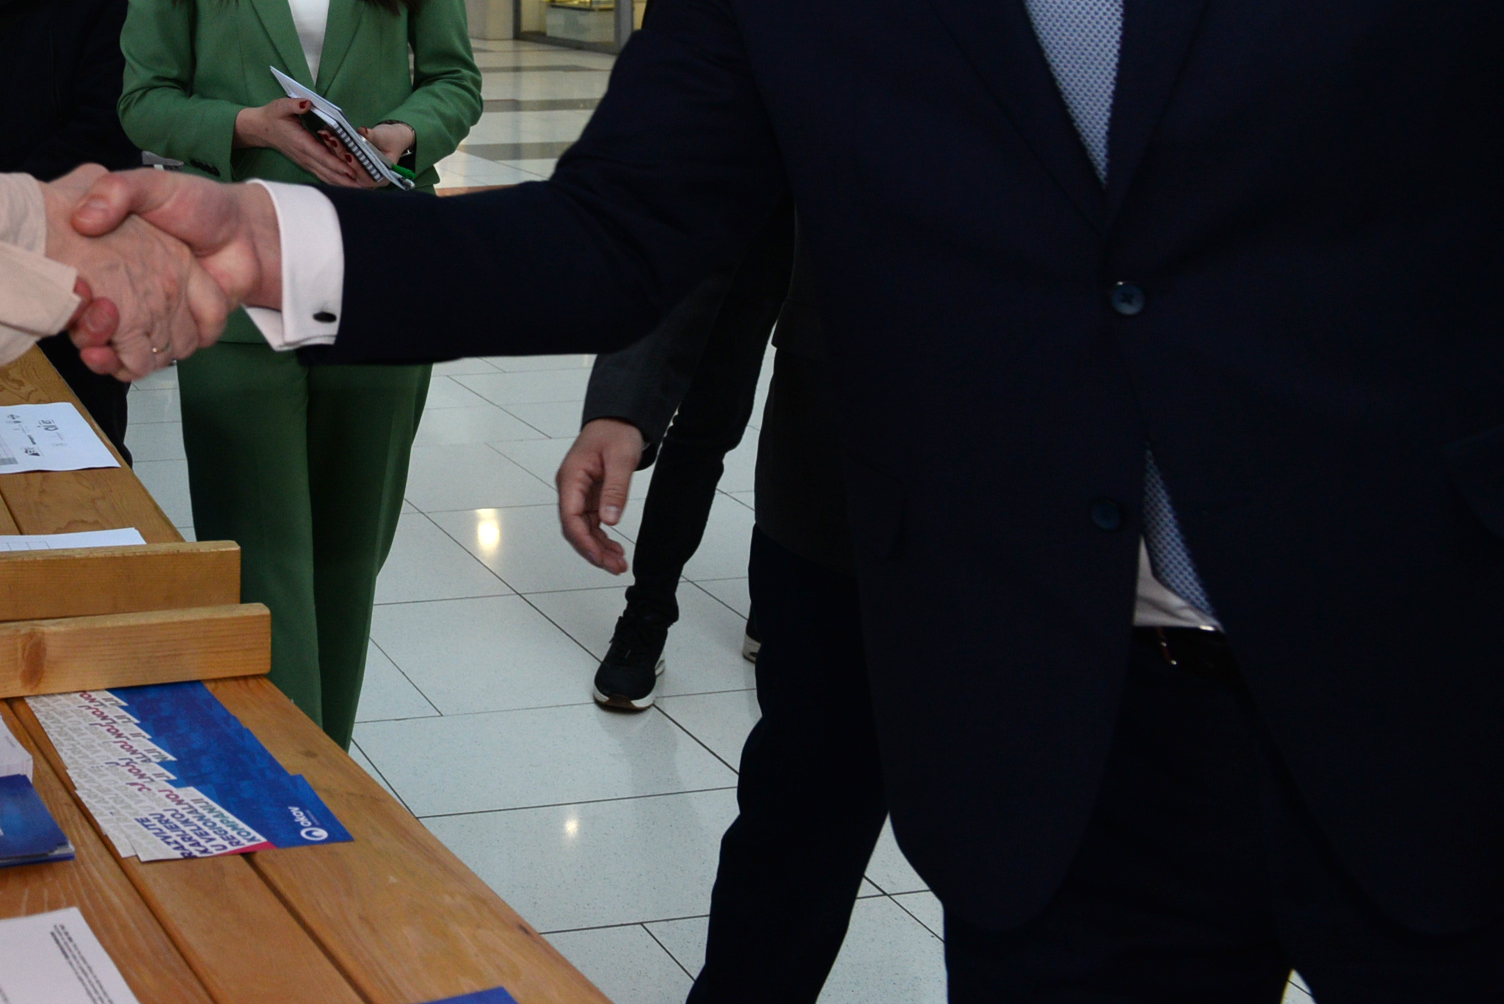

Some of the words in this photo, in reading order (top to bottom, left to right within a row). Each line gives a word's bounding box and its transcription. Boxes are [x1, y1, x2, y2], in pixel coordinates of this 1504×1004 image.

[149, 813, 213, 855] KARIJERU
[159, 789, 246, 847] REGIONALNOJ
[163, 809, 215, 844] VELIKOJ
[191, 798, 262, 844] KOMPANIJI
[287, 806, 312, 827] okov
[134, 817, 197, 859] RAZVIJTE
[211, 844, 227, 852] U
